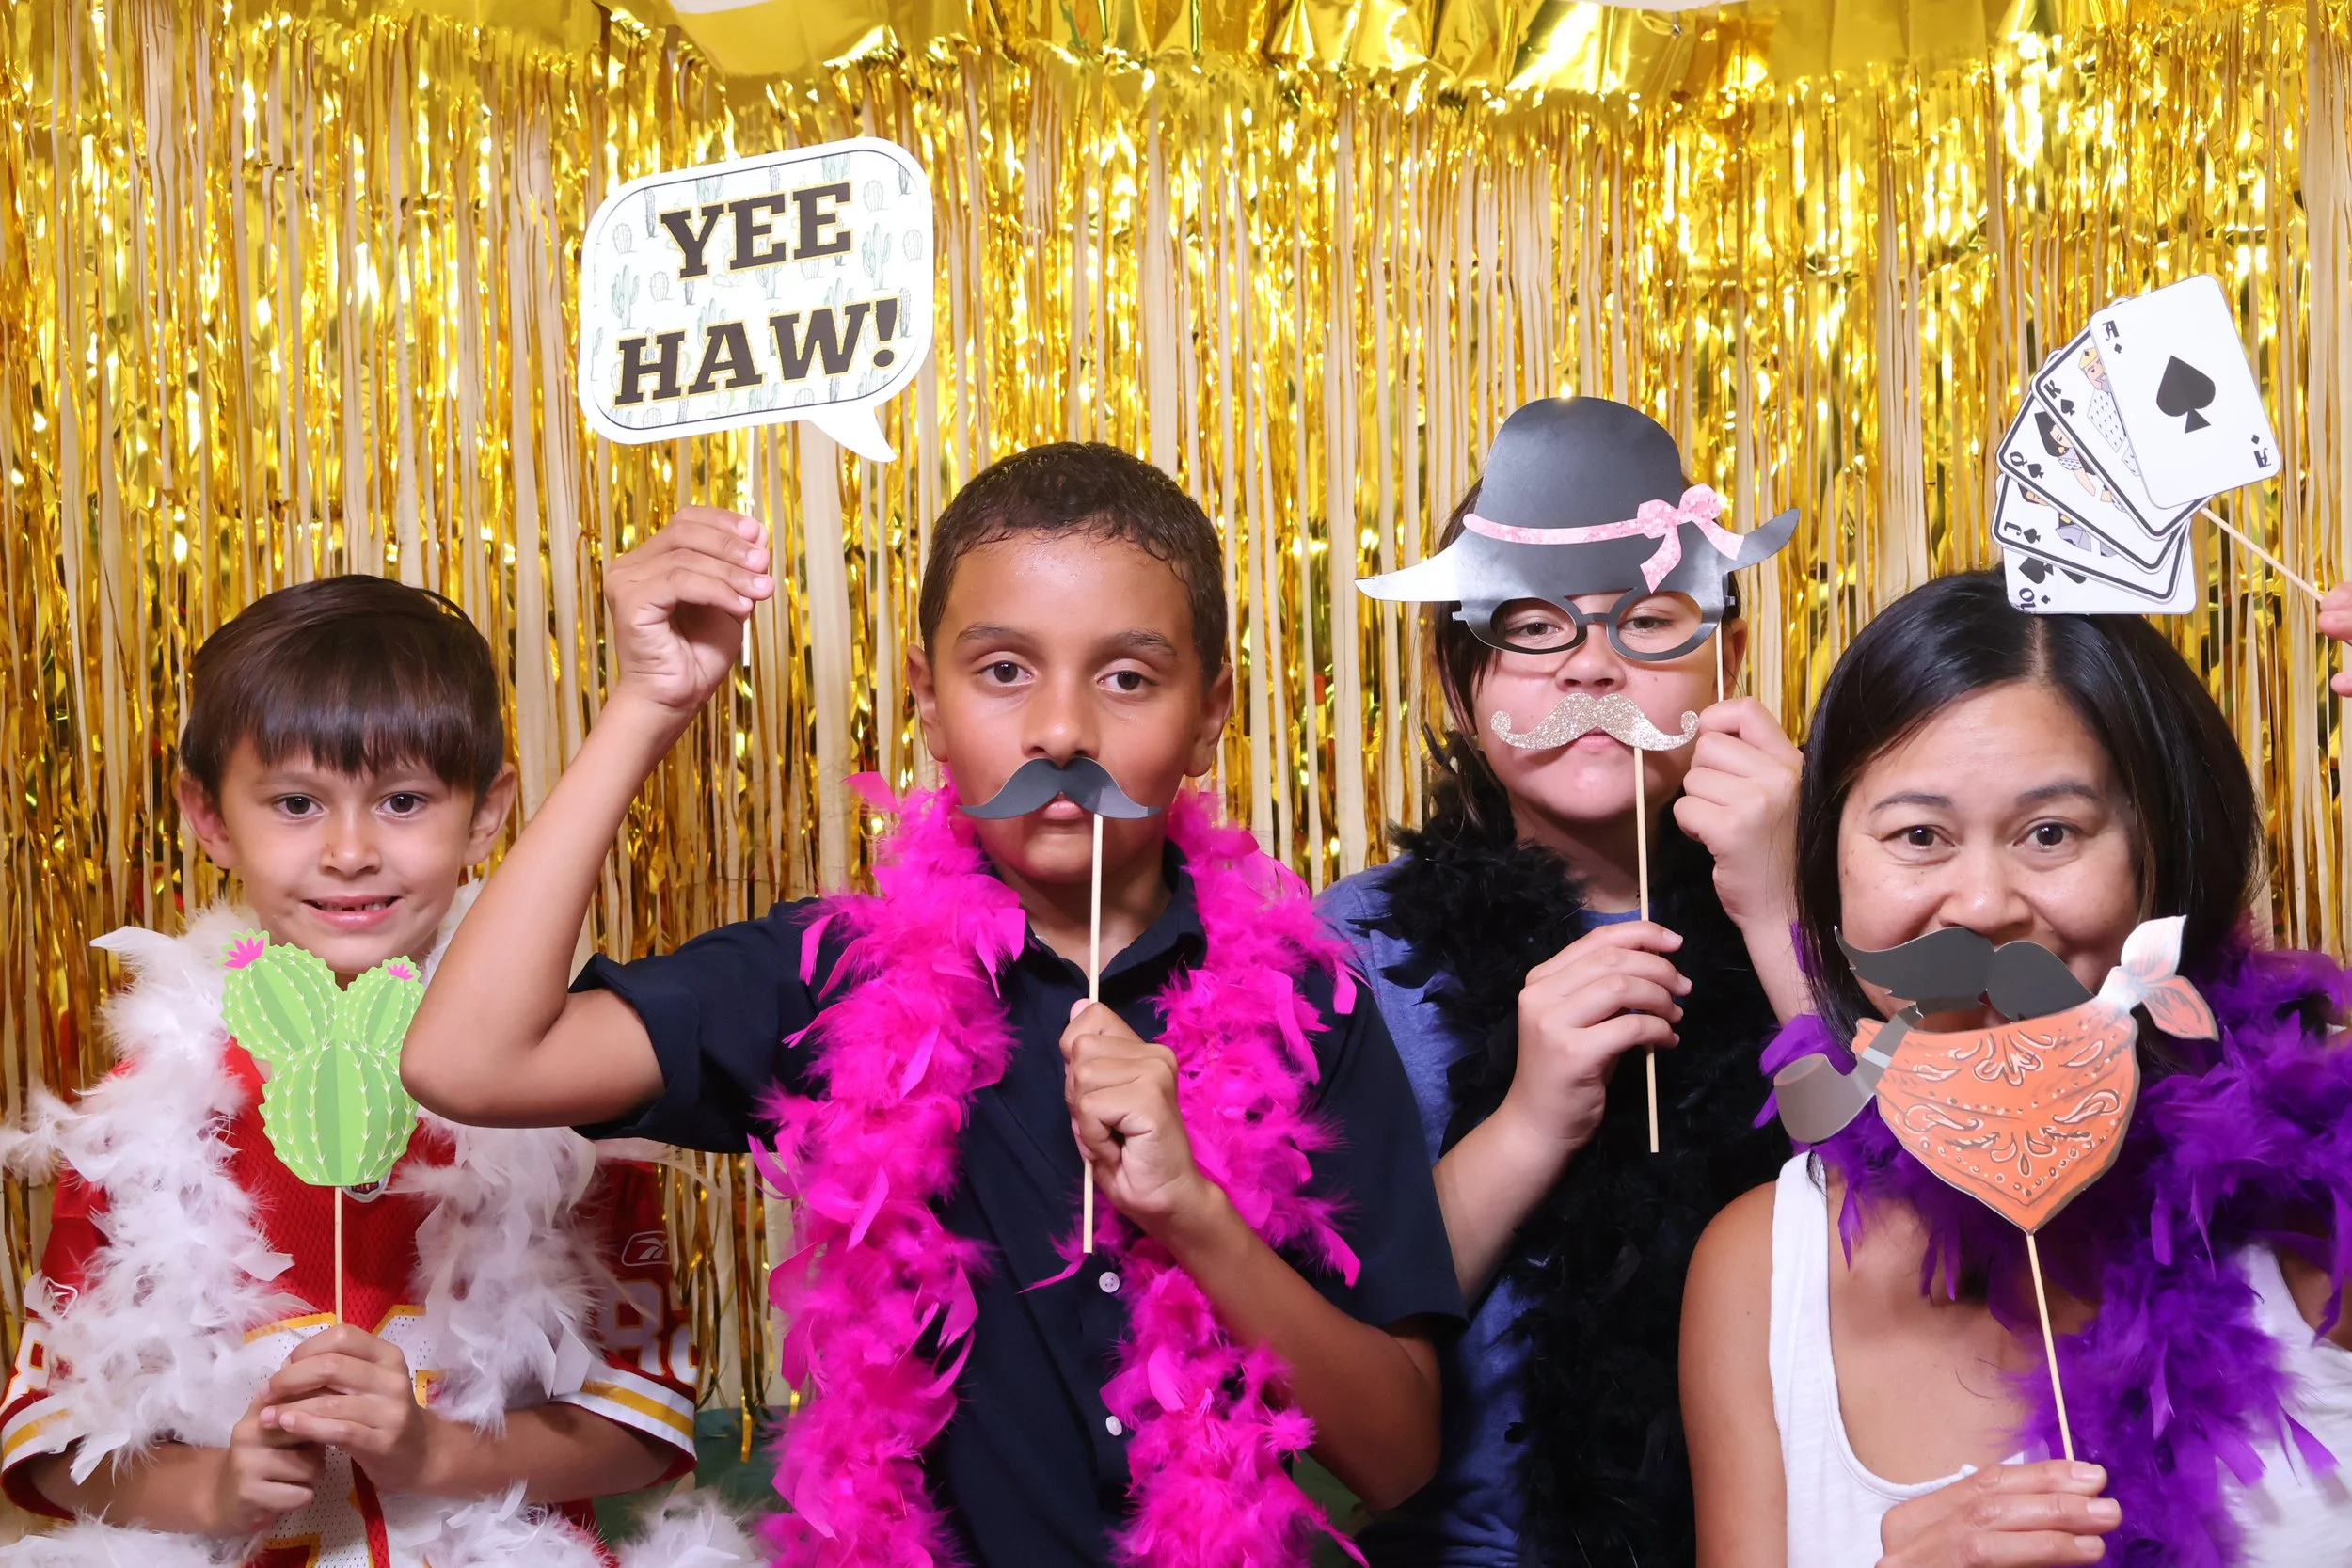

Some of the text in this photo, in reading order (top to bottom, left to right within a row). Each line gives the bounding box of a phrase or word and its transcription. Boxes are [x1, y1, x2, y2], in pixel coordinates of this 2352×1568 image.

[660, 181, 852, 279] YEE
[2102, 320, 2120, 341] A
[613, 295, 900, 408] HAW!
[2043, 379, 2062, 399] K
[2010, 451, 2027, 467] Q
[2253, 447, 2272, 468] A
[2004, 521, 2022, 536] J
